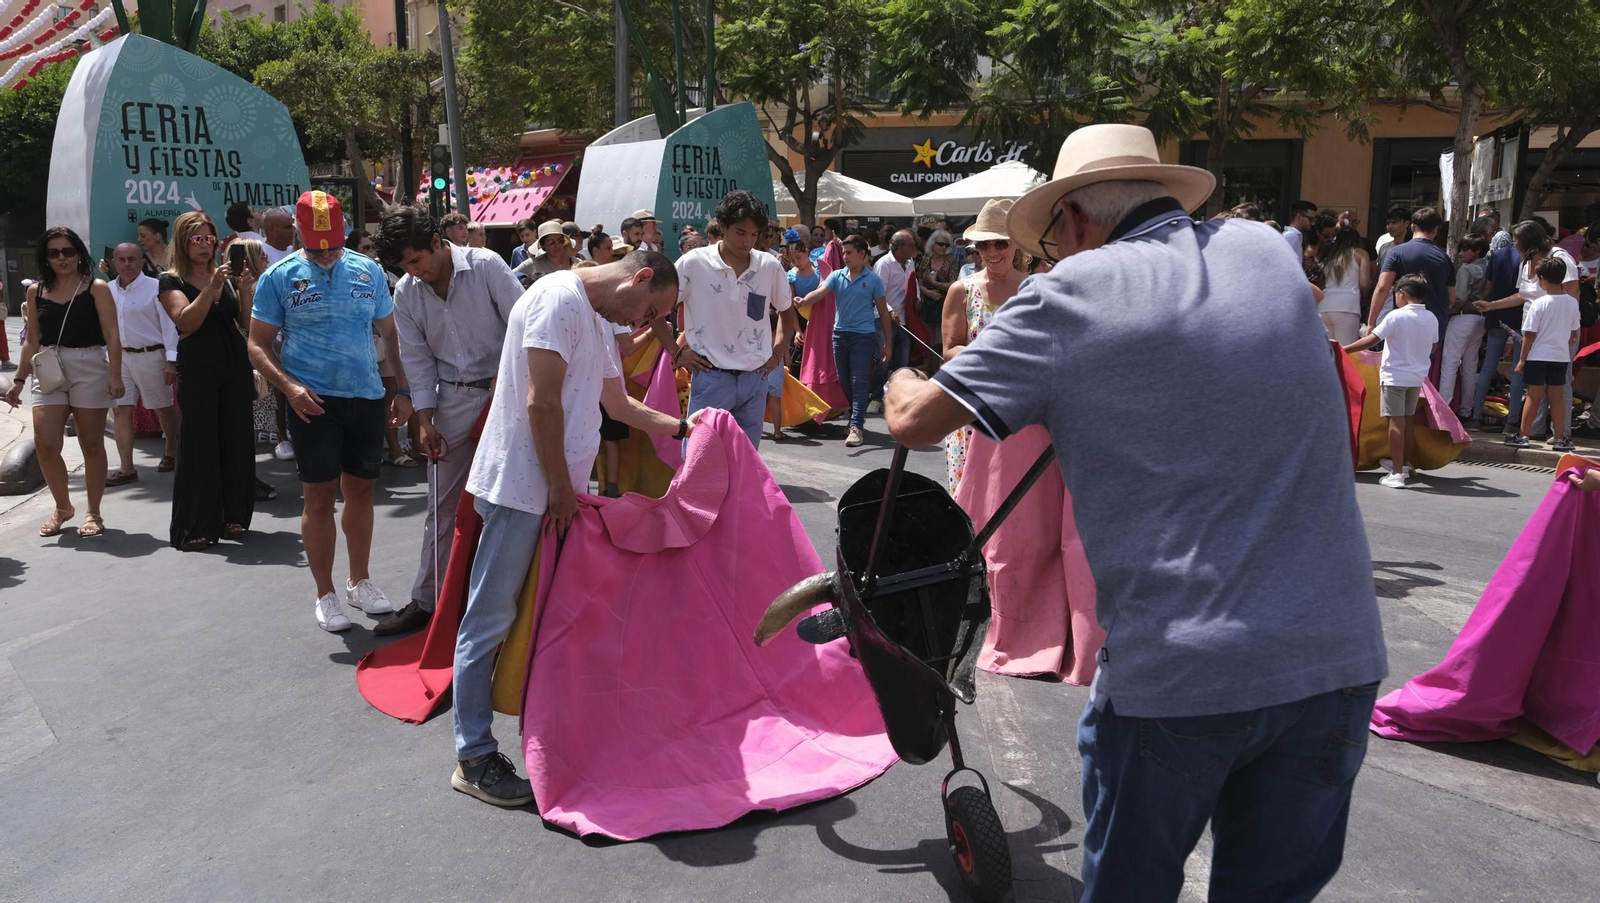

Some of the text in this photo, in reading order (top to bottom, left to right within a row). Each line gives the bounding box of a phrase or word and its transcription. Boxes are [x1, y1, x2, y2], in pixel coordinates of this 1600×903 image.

[890, 173, 963, 183] CALIFORNIA
[125, 179, 180, 205] 2024
[672, 201, 703, 219] 2024
[290, 291, 323, 309] Monte
